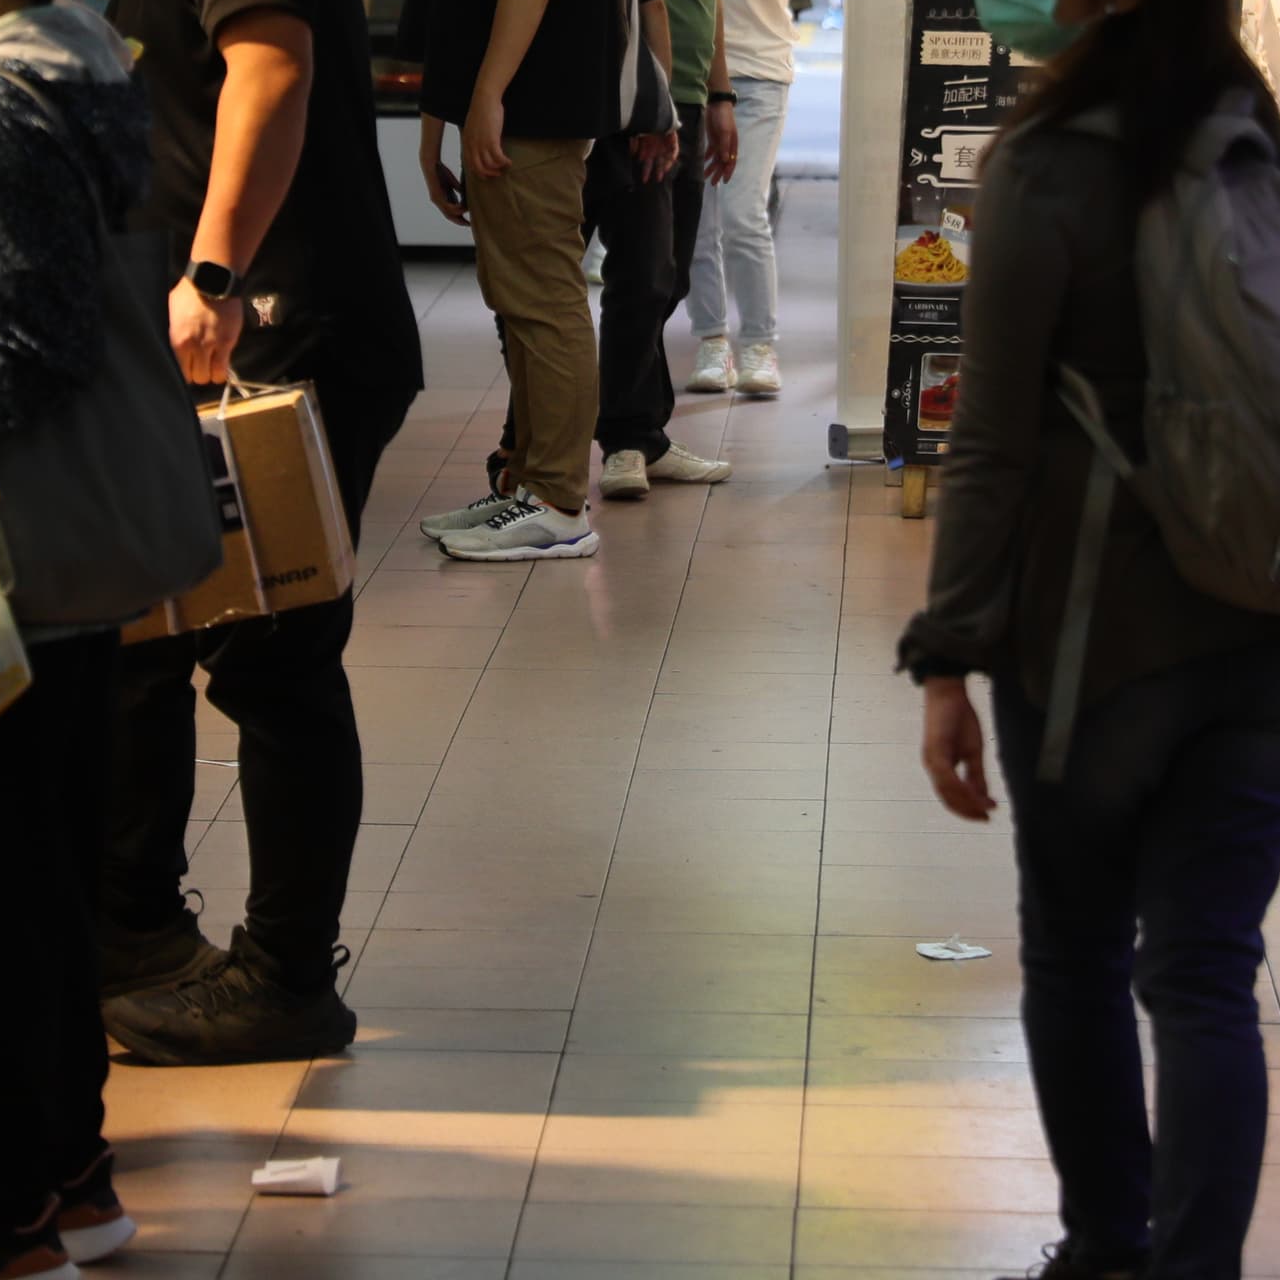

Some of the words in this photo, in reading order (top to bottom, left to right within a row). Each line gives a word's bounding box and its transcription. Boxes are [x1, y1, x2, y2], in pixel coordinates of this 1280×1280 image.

[928, 36, 985, 47] SPAGHETTI
[943, 84, 988, 104] 加配料
